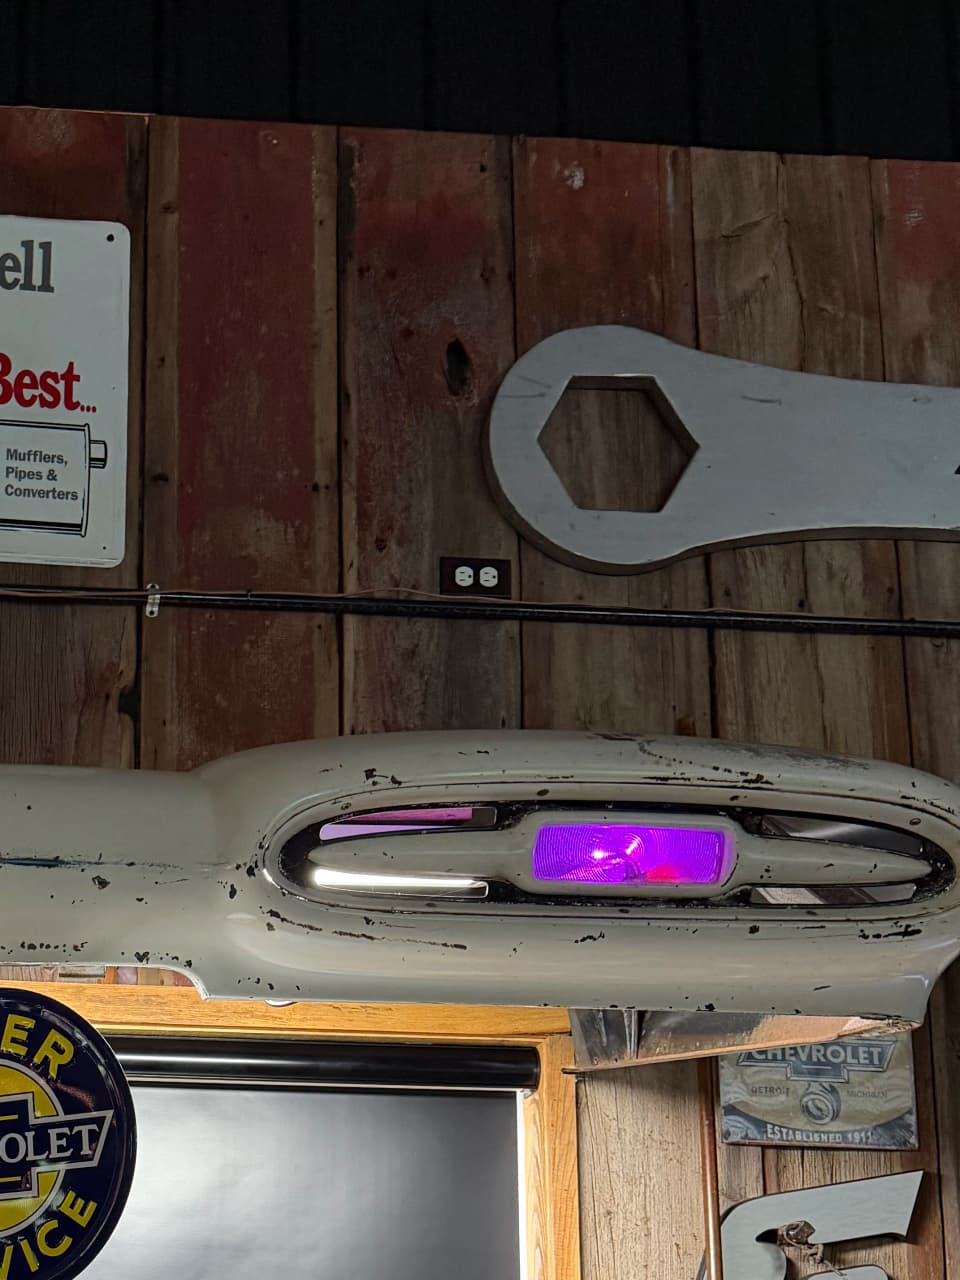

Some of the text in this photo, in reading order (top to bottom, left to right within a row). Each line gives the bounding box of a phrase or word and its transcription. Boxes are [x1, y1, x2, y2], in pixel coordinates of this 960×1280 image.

[5, 447, 69, 467] Mufflers,
[5, 466, 58, 483] Pipes &
[4, 483, 79, 502] Converters
[751, 1044, 883, 1066] CHEVROLET
[767, 1124, 873, 1144] ESTABLISHED 1911
